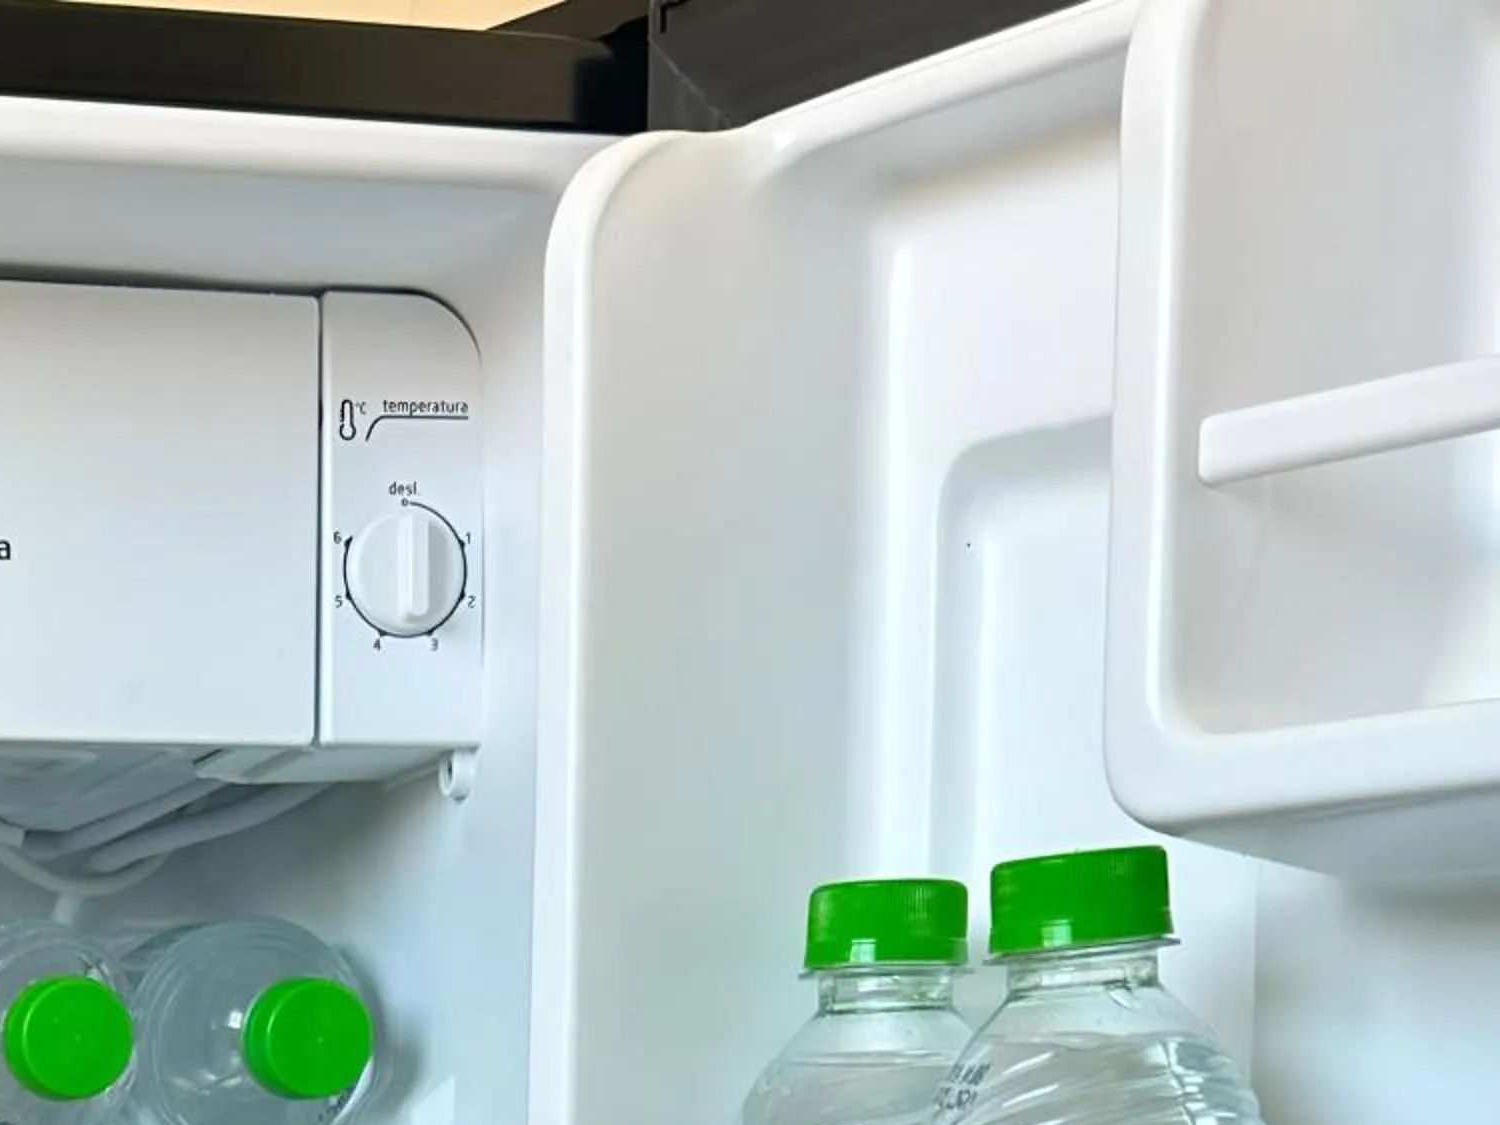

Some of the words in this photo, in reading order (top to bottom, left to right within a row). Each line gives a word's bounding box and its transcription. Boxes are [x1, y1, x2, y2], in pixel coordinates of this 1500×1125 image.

[383, 399, 469, 417] temperatura
[333, 531, 343, 544] 6
[465, 532, 472, 545] 1
[335, 595, 343, 608] 5
[467, 595, 476, 608] 2
[373, 637, 382, 651] 4
[430, 637, 439, 651] 3
